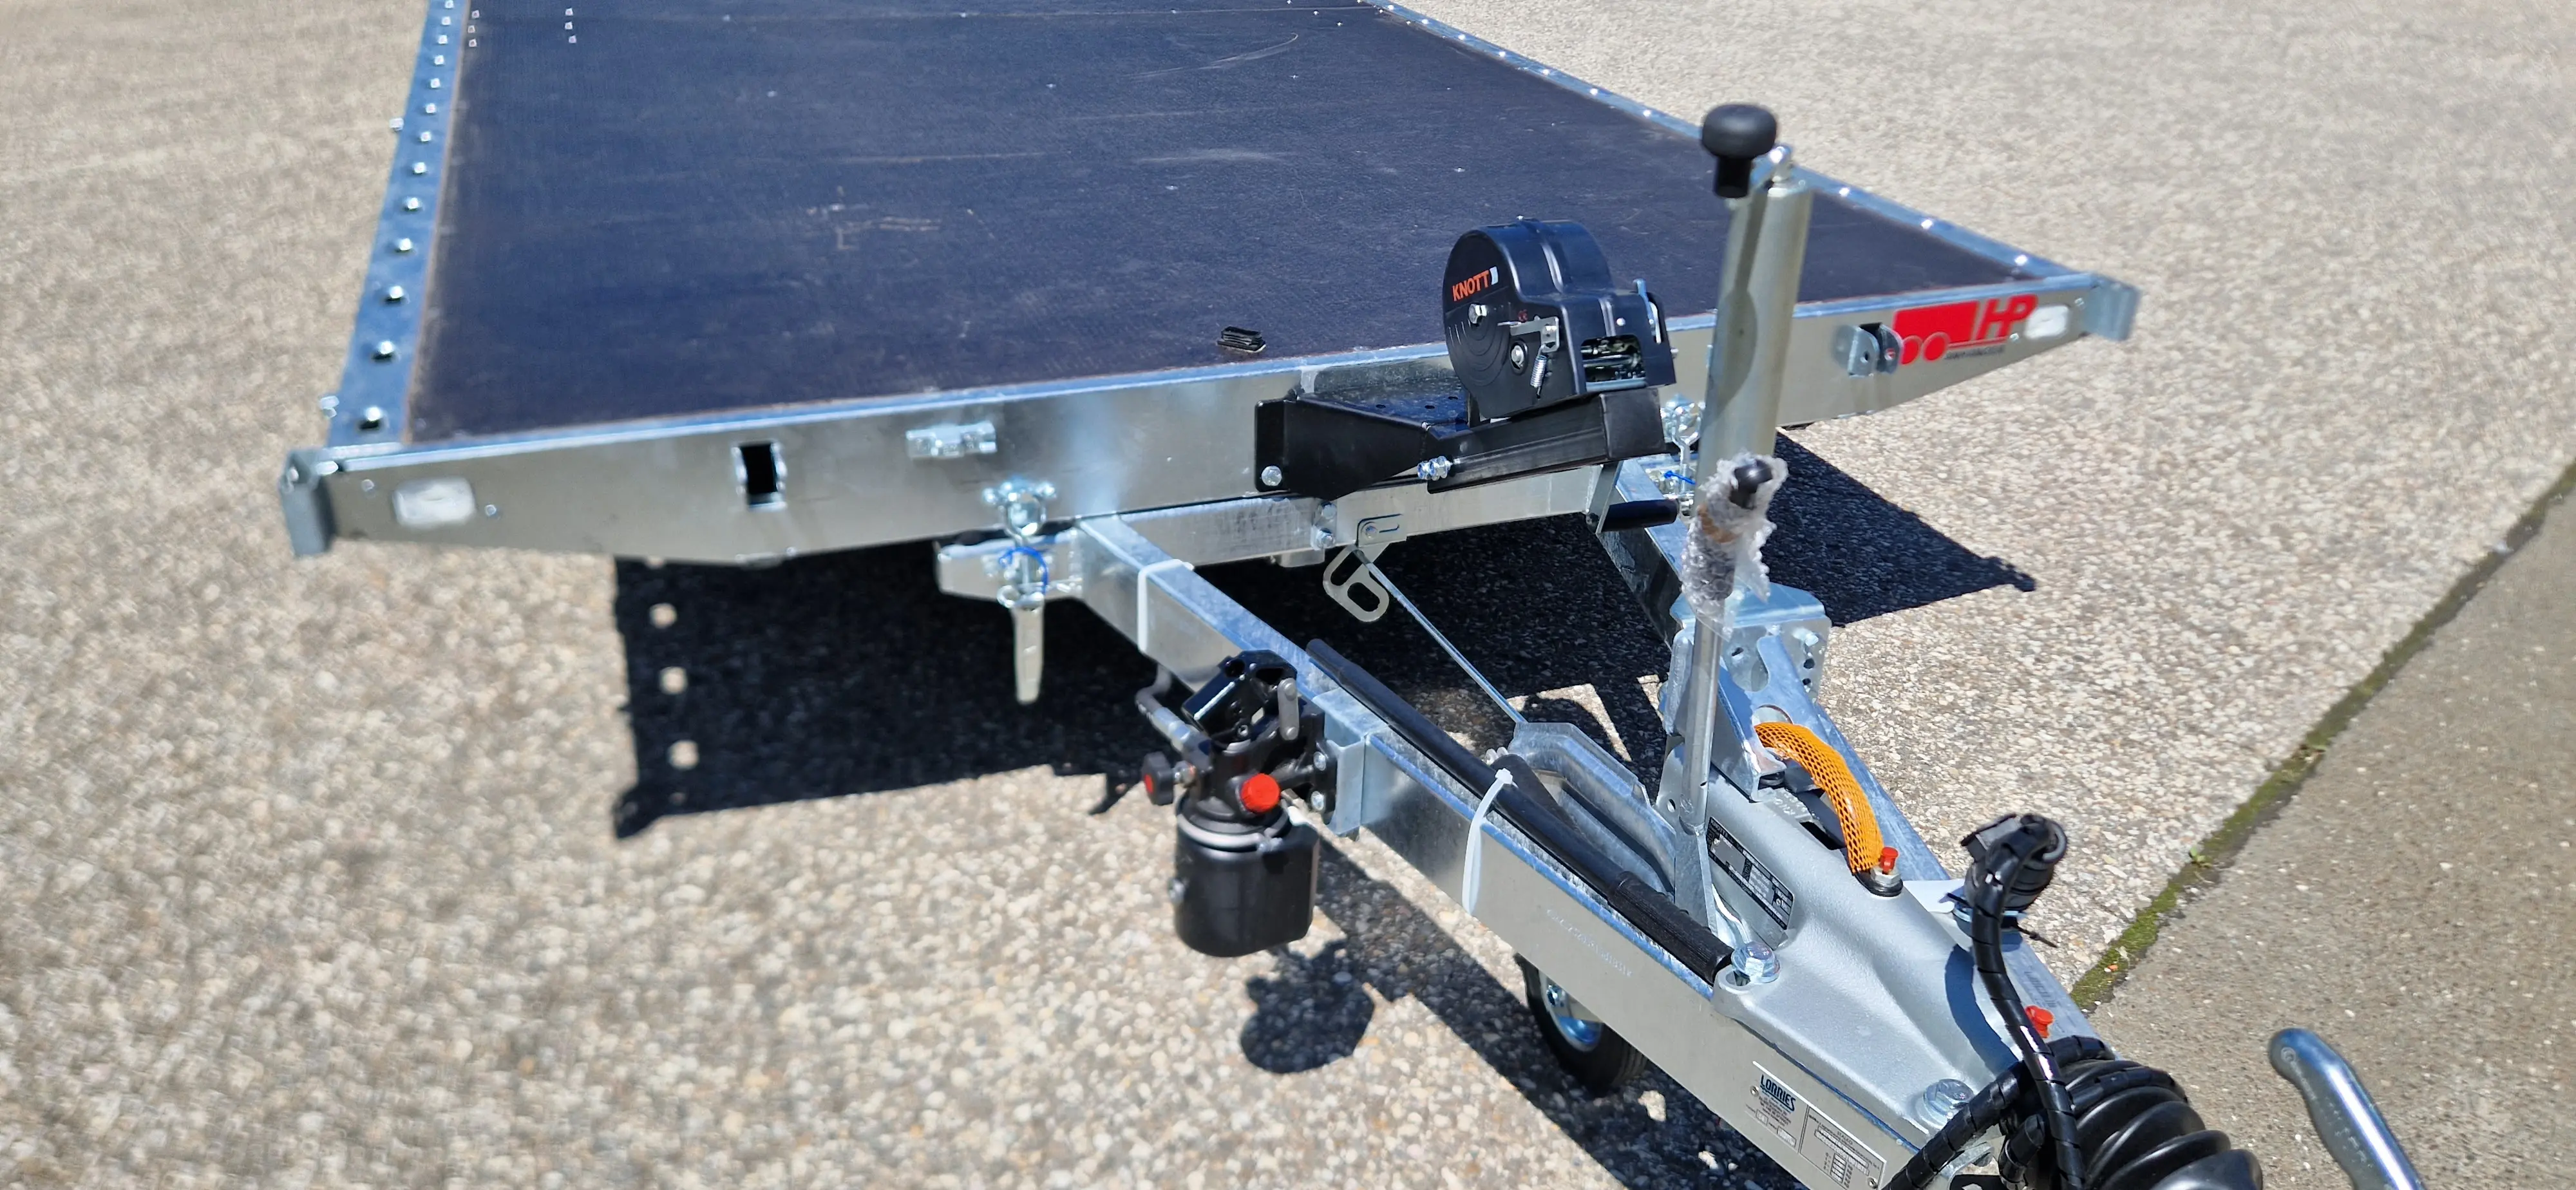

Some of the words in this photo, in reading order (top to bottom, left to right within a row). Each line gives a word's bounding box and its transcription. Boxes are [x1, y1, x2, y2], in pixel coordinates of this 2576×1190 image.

[1452, 269, 1490, 302] KNOTT
[1975, 292, 2038, 341] HP
[1760, 1073, 1796, 1111] LORRIES
